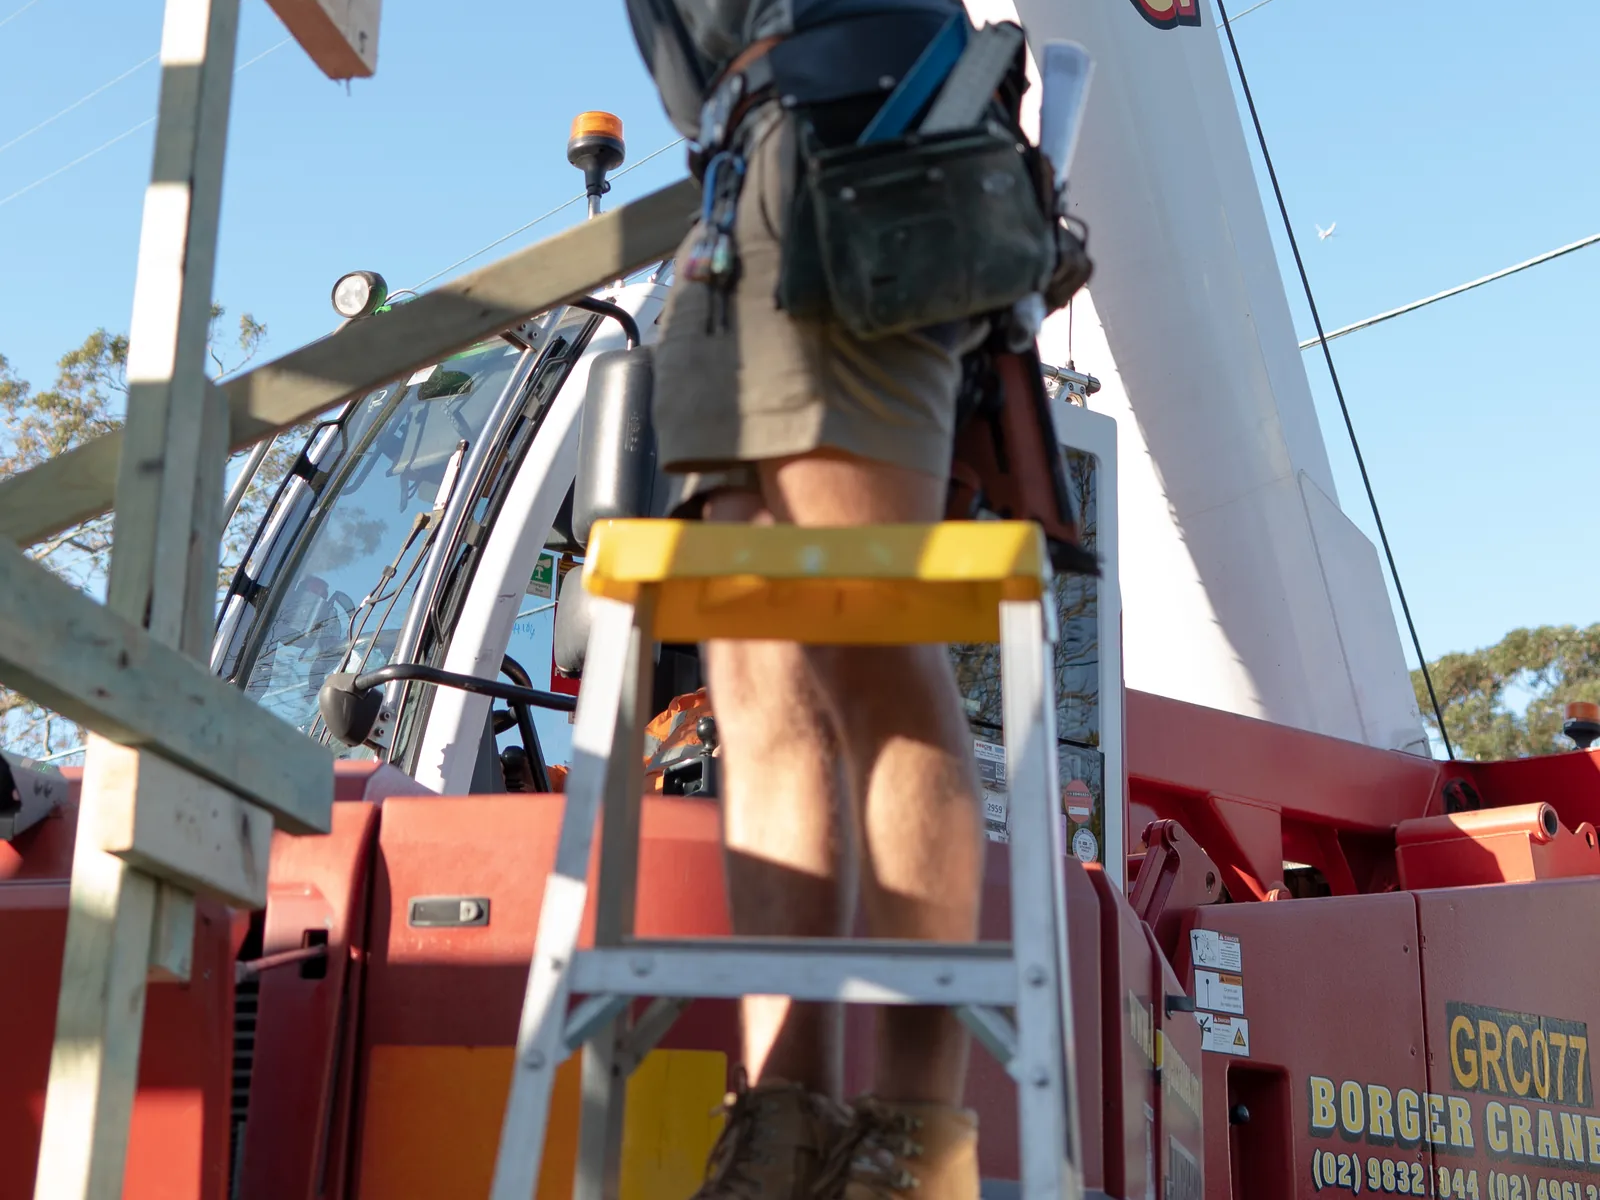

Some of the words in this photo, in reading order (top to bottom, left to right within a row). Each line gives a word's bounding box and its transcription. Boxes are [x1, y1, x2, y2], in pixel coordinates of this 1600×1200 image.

[1450, 1015, 1587, 1104] GRC077
[1310, 1076, 1474, 1148] BORGER
[1313, 1148, 1362, 1194] (02)
[1367, 1157, 1425, 1195] 9832
[1488, 1169, 1531, 1200] (02)
